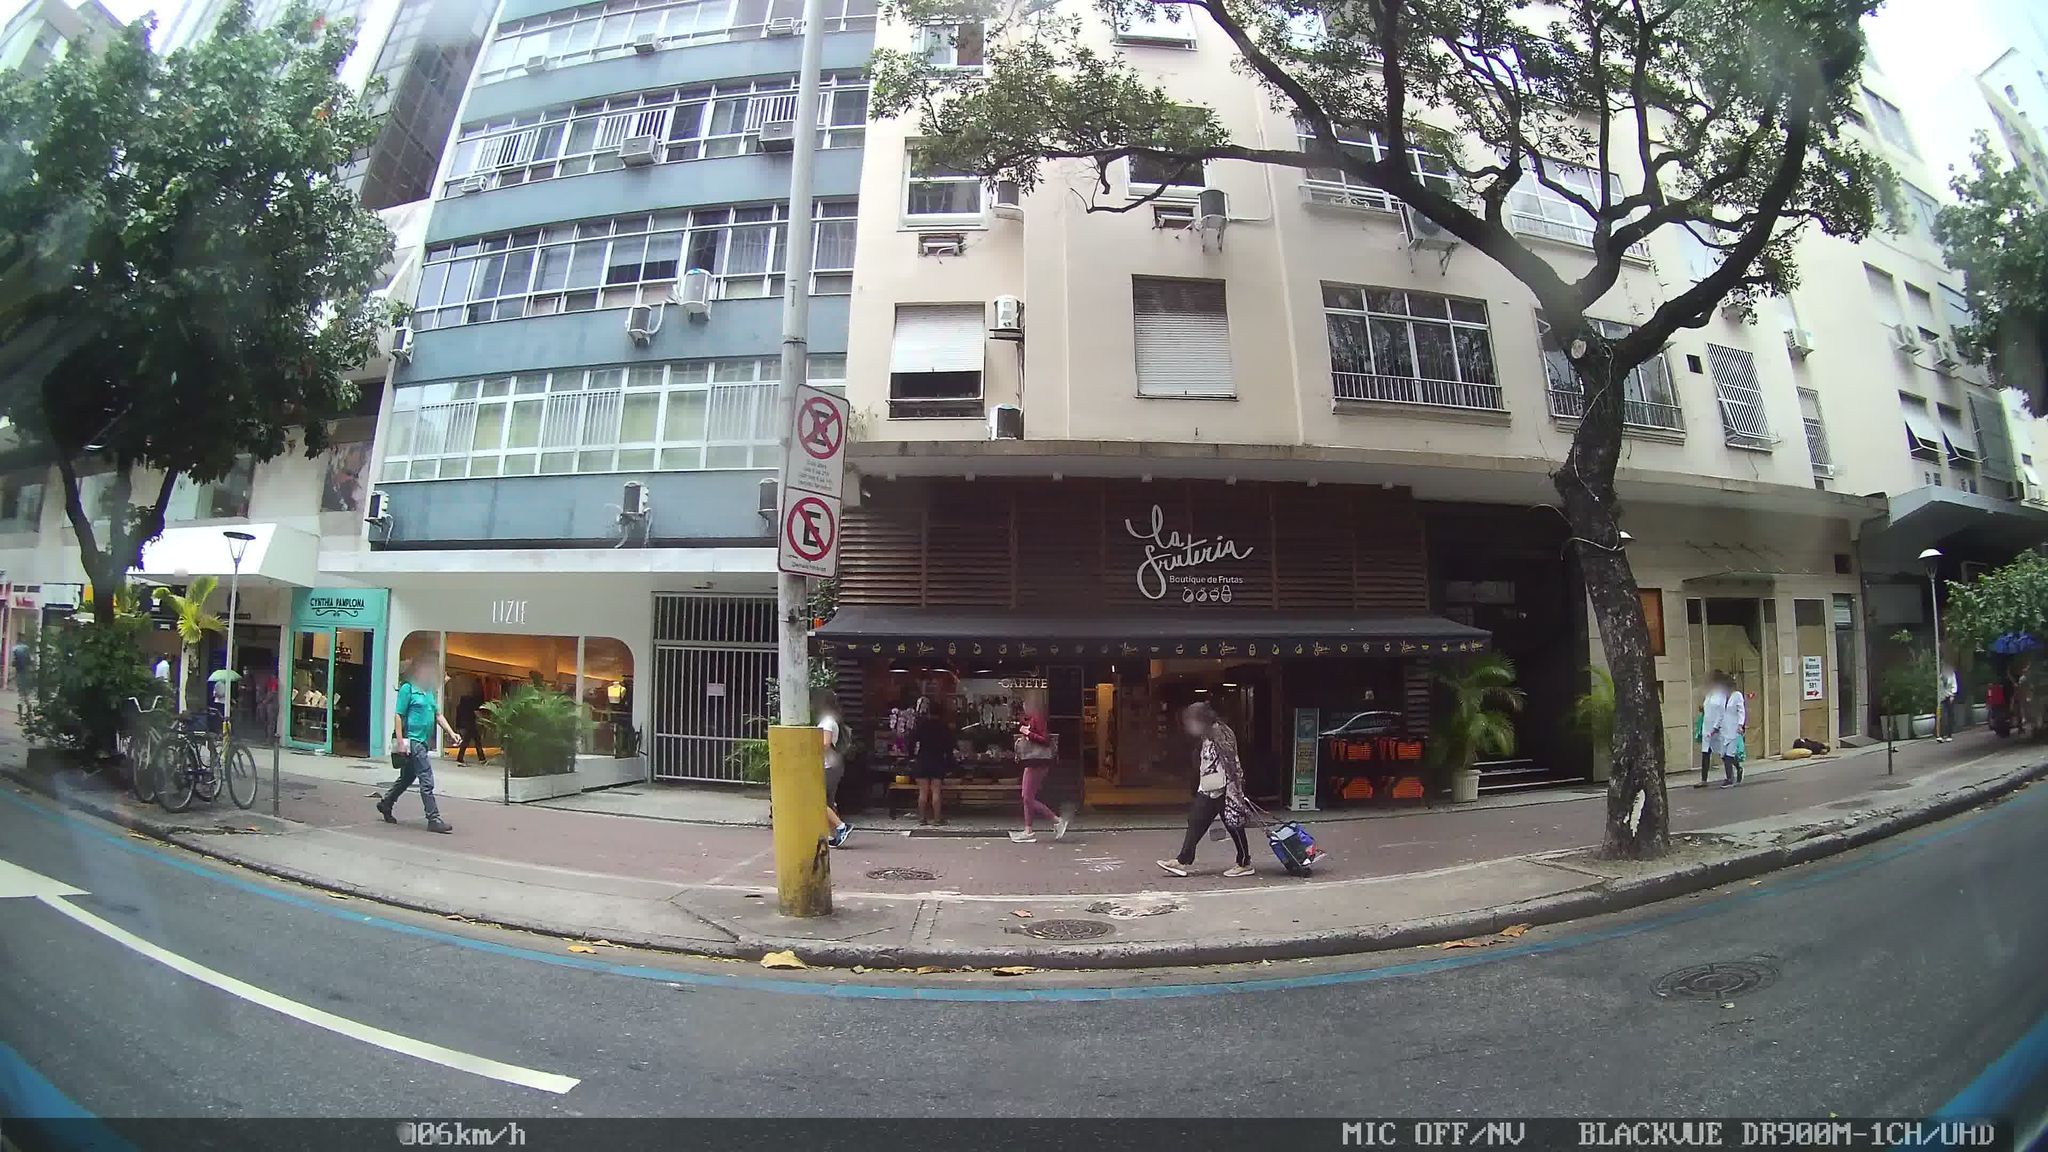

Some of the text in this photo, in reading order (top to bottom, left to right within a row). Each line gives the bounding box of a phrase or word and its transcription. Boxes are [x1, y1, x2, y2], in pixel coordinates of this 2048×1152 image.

[1169, 575, 1244, 585] Boutique de Frutas
[310, 597, 365, 608] CYNTHIA PAMPLONA
[492, 600, 529, 624] LIZIE
